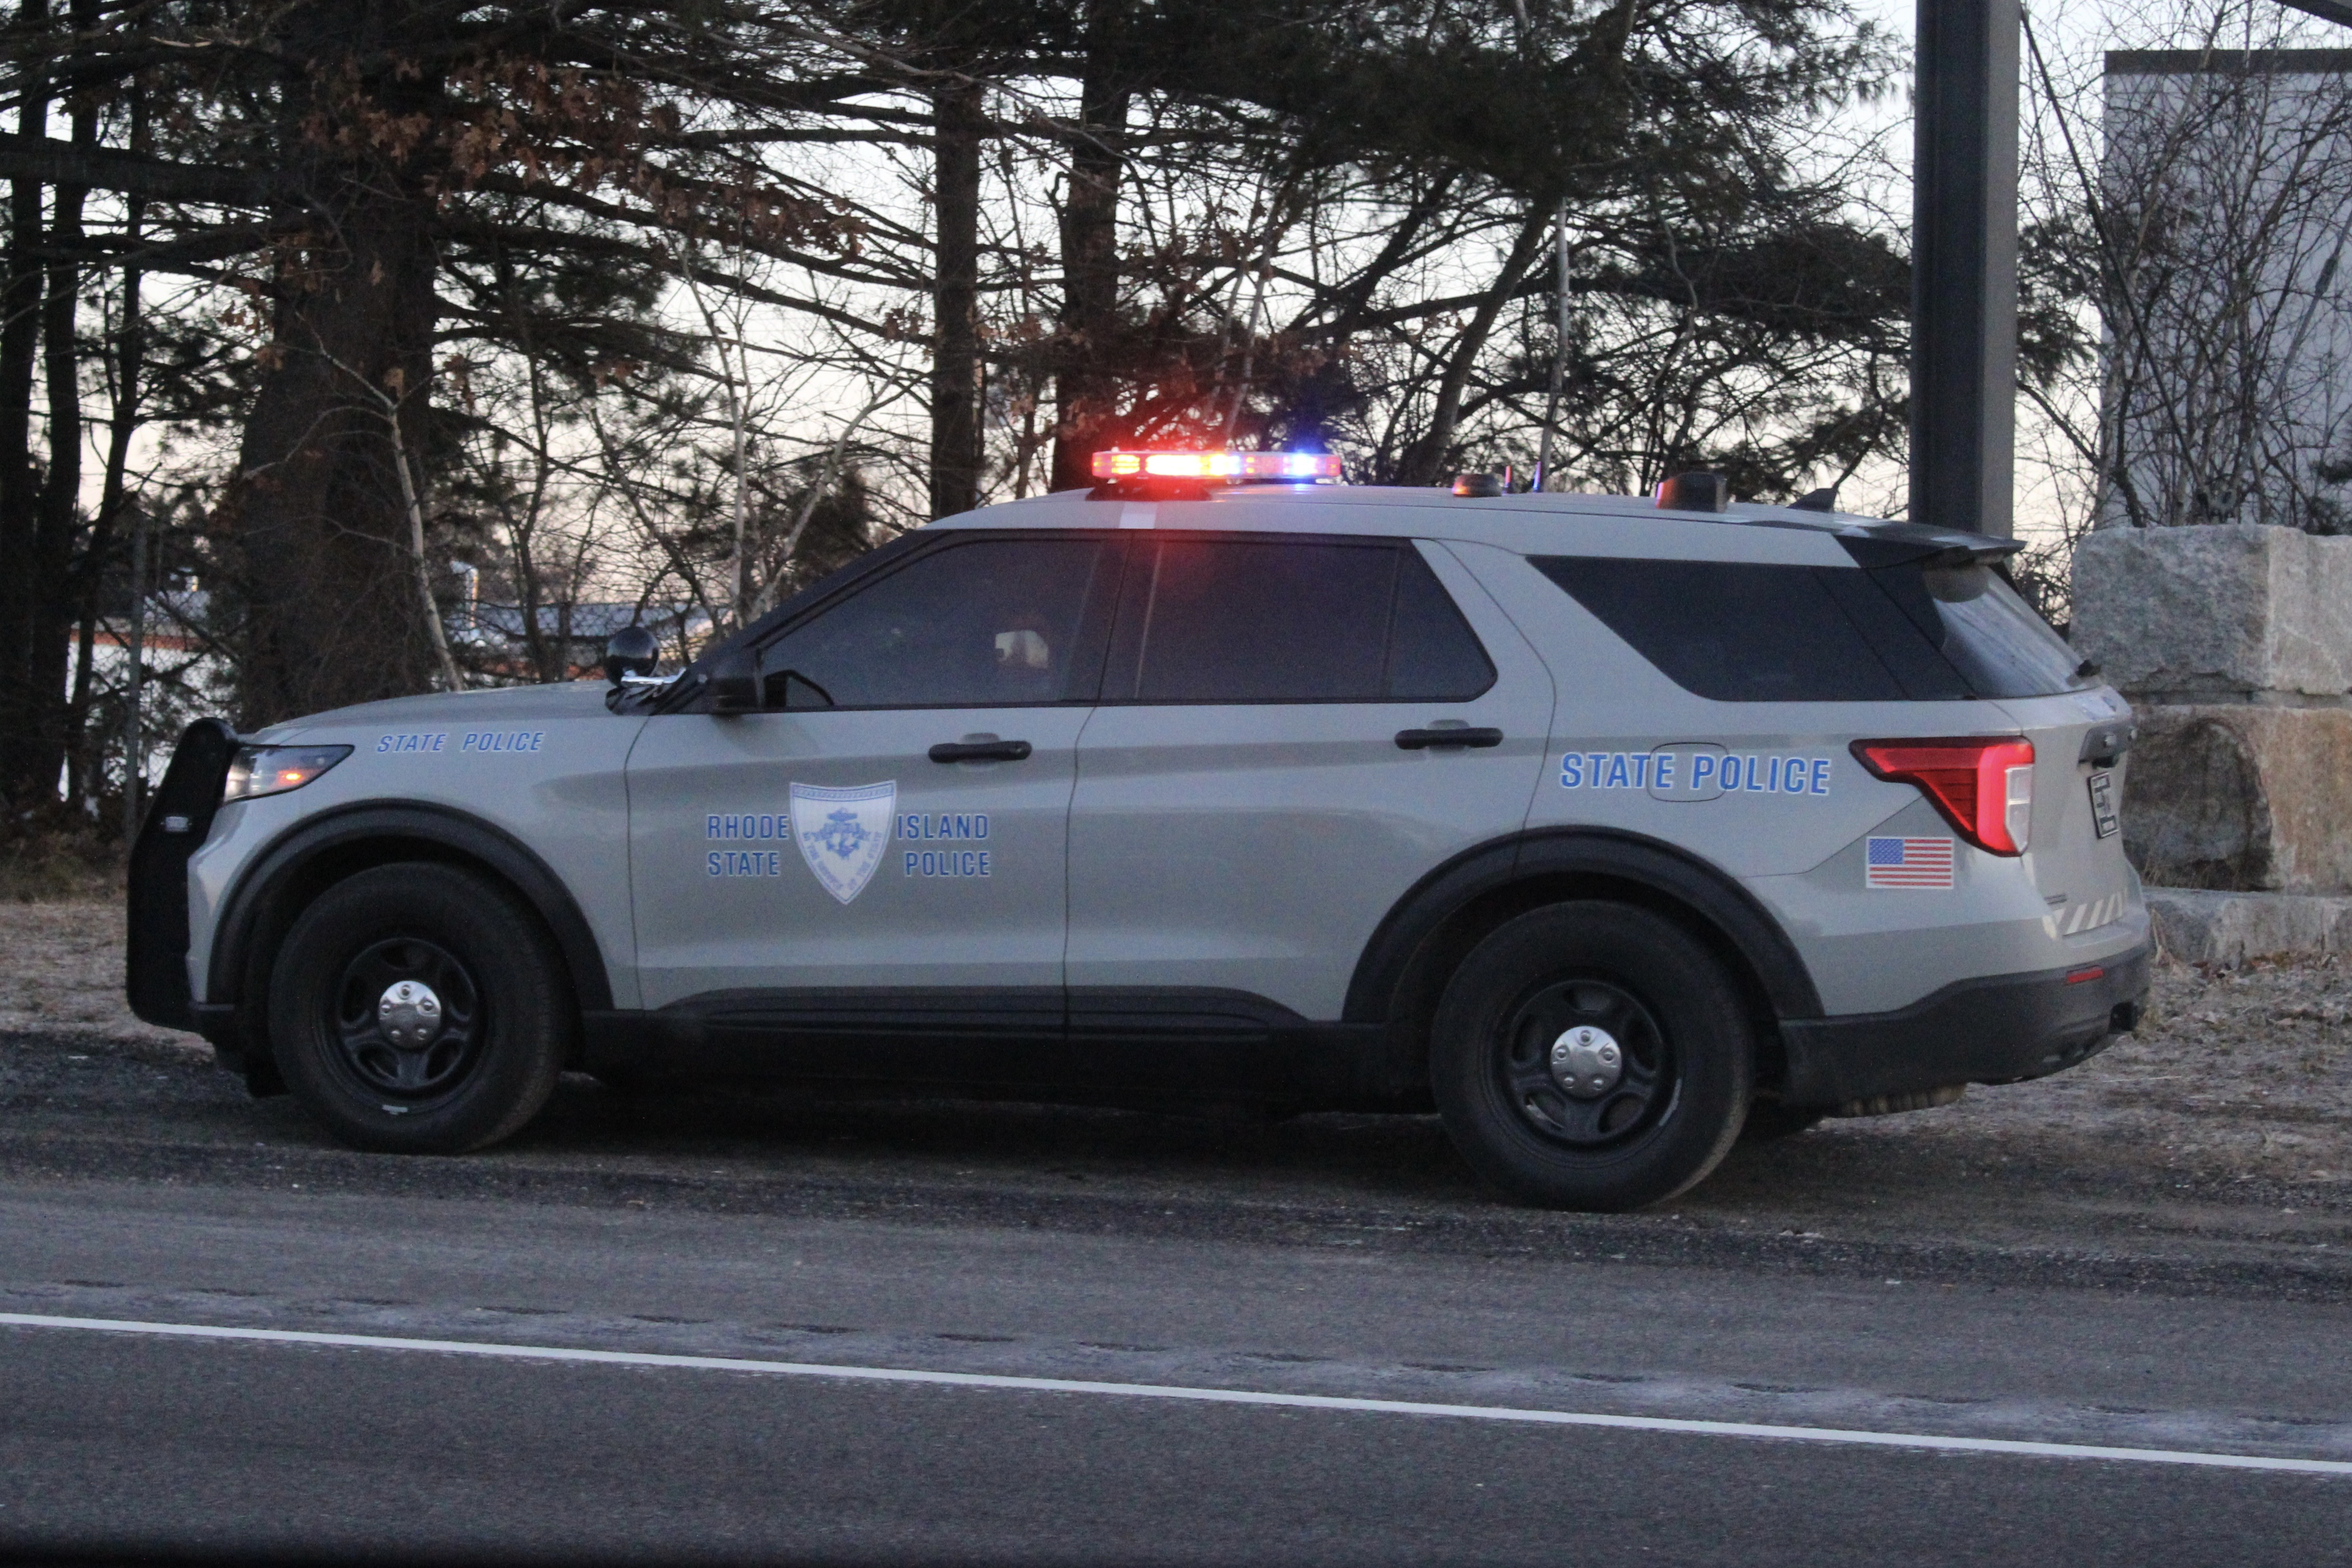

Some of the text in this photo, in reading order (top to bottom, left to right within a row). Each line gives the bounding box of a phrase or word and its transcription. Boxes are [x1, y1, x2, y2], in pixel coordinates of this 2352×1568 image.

[377, 732, 544, 752] STATE POLICE
[1561, 752, 1831, 795] STATE POLICE
[707, 813, 988, 840] RHODE ISLAND
[707, 851, 779, 876] STATE
[904, 851, 990, 876] POLICE
